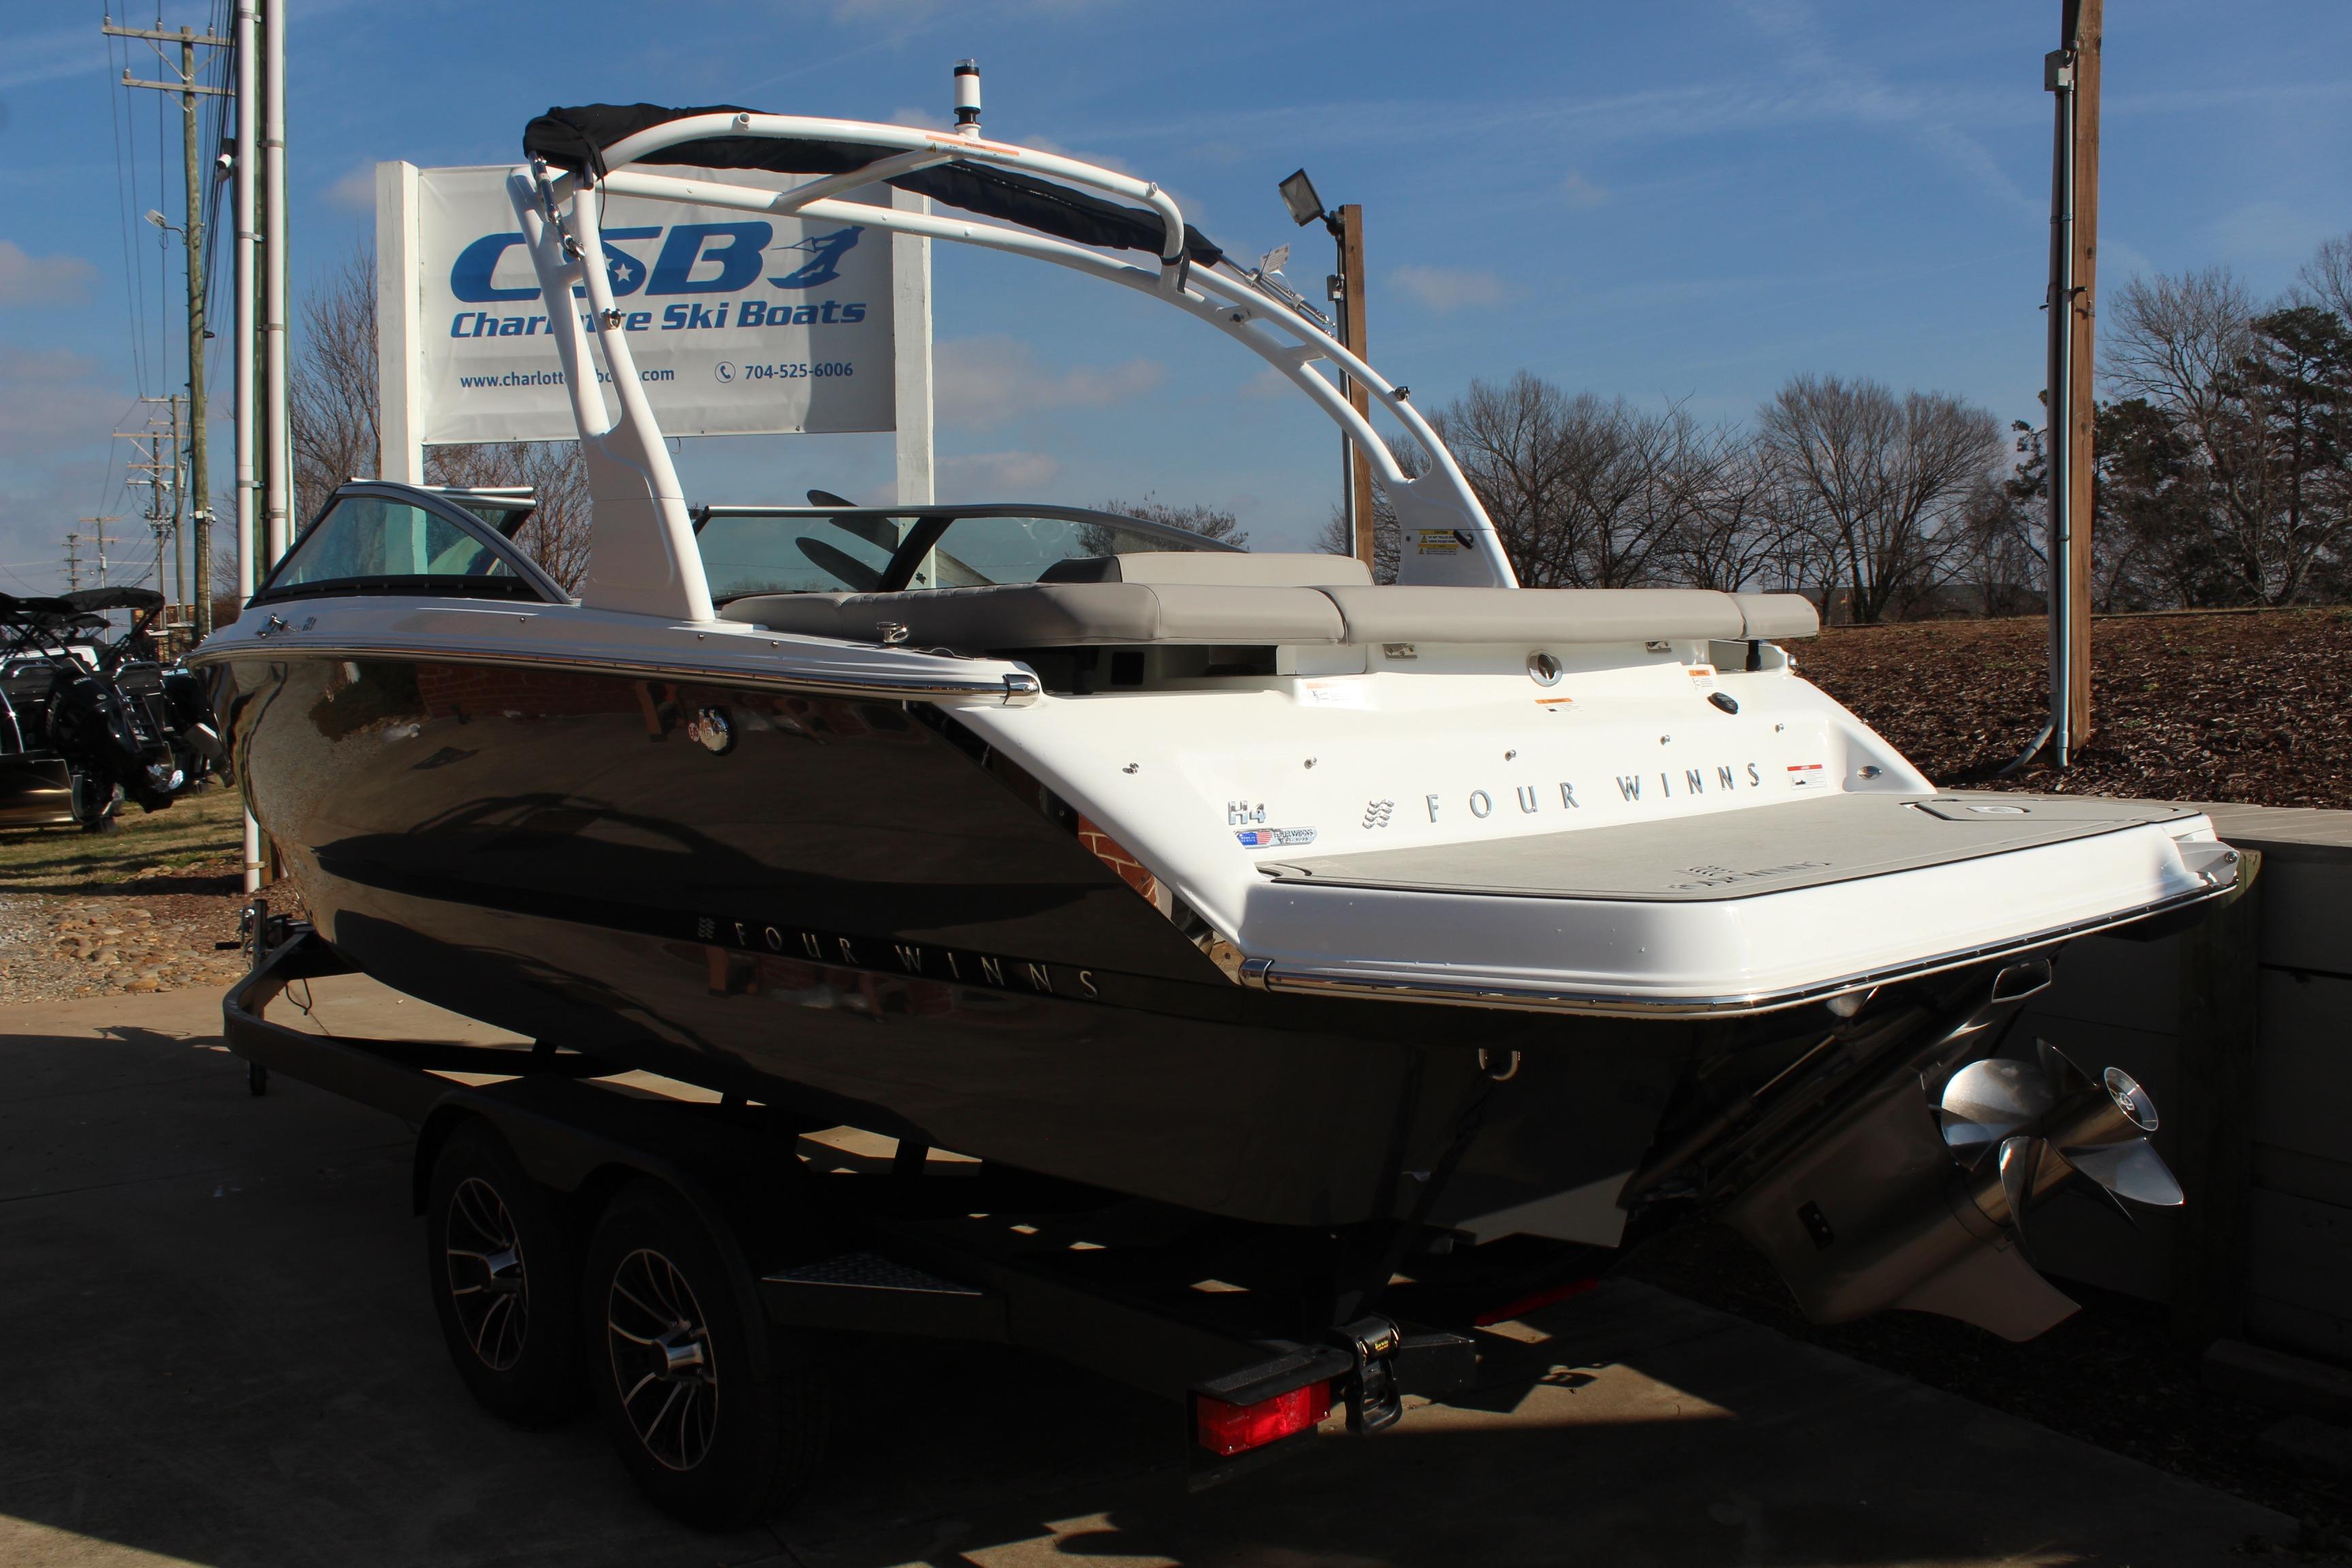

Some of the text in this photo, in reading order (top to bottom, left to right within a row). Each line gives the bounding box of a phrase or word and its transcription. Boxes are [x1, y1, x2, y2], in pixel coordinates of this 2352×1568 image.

[450, 220, 773, 304] CSB
[661, 302, 730, 330] Ski
[736, 300, 867, 328] Boats
[745, 362, 854, 380] 704-525-6006
[1228, 800, 1267, 825] H4
[1426, 762, 1761, 823] FOUR WINNS
[734, 920, 1100, 998] FOUR WINNS
